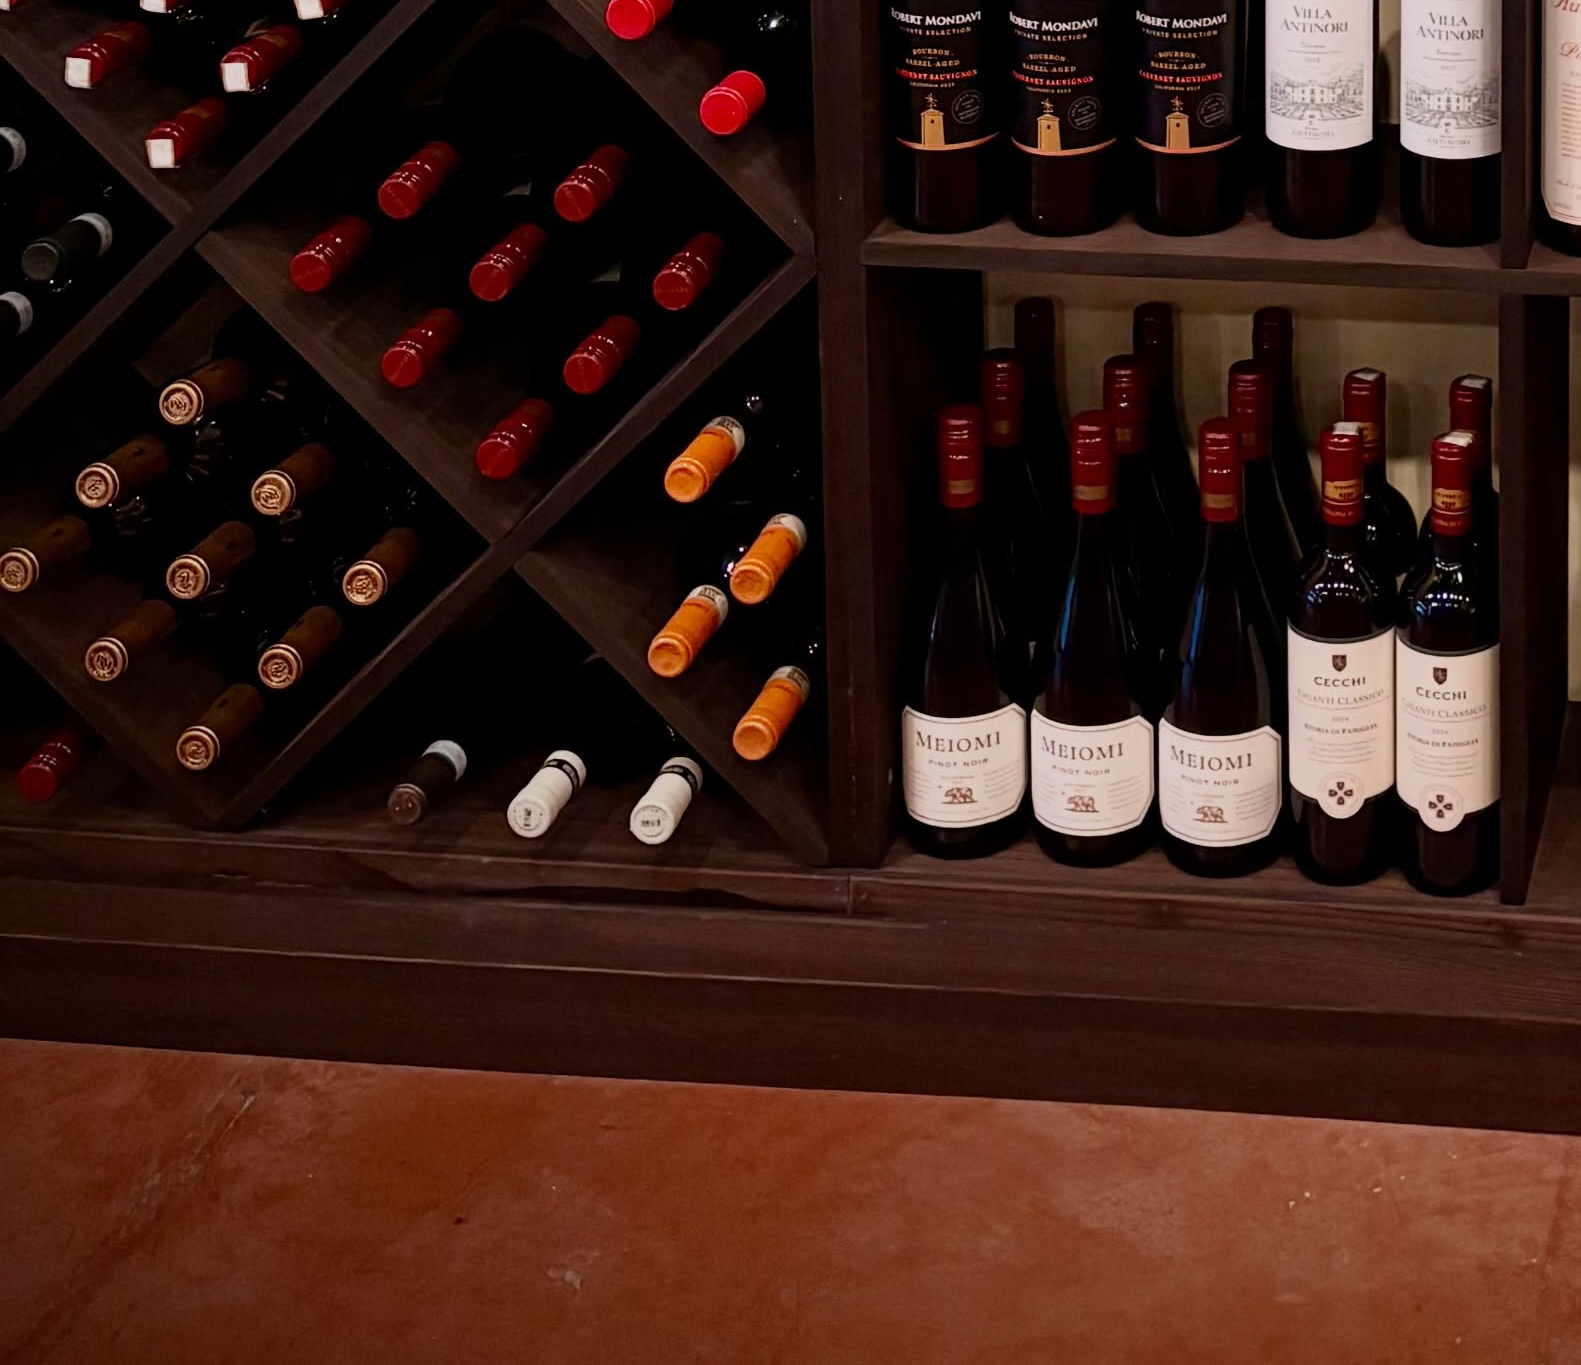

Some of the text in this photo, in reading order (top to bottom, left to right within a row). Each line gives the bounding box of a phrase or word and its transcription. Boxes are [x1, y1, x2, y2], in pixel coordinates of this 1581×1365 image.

[925, 10, 982, 26] MONDAVI
[1136, 10, 1228, 29] ROBERT MONDAVI
[1293, 5, 1332, 20] VILLA
[1429, 12, 1468, 26] VILLA
[925, 26, 972, 36] SELECTION
[1041, 17, 1098, 32] MONDAVI
[1281, 18, 1348, 33] ANTINORI
[1042, 33, 1088, 42] SELECTION
[1172, 29, 1218, 39] SELECTION
[1417, 25, 1484, 41] ANTINORI
[929, 69, 977, 81] SAUVIGNON
[1046, 75, 1094, 86] SAUVIGNON
[1176, 72, 1223, 84] SAUVIGNON
[1314, 675, 1367, 688] CECCHI
[1337, 689, 1385, 705] CLASSICO
[1415, 686, 1468, 701] CECCHI
[1437, 703, 1488, 718] CLASSICO
[916, 730, 1001, 752] MEIOMI
[1042, 735, 1124, 761] MEIOMI
[928, 758, 989, 768] PINOT NOIR
[1170, 744, 1252, 771] MEIOMI
[1085, 768, 1110, 776] NOIR
[1181, 774, 1239, 786] PINOT NOIR
